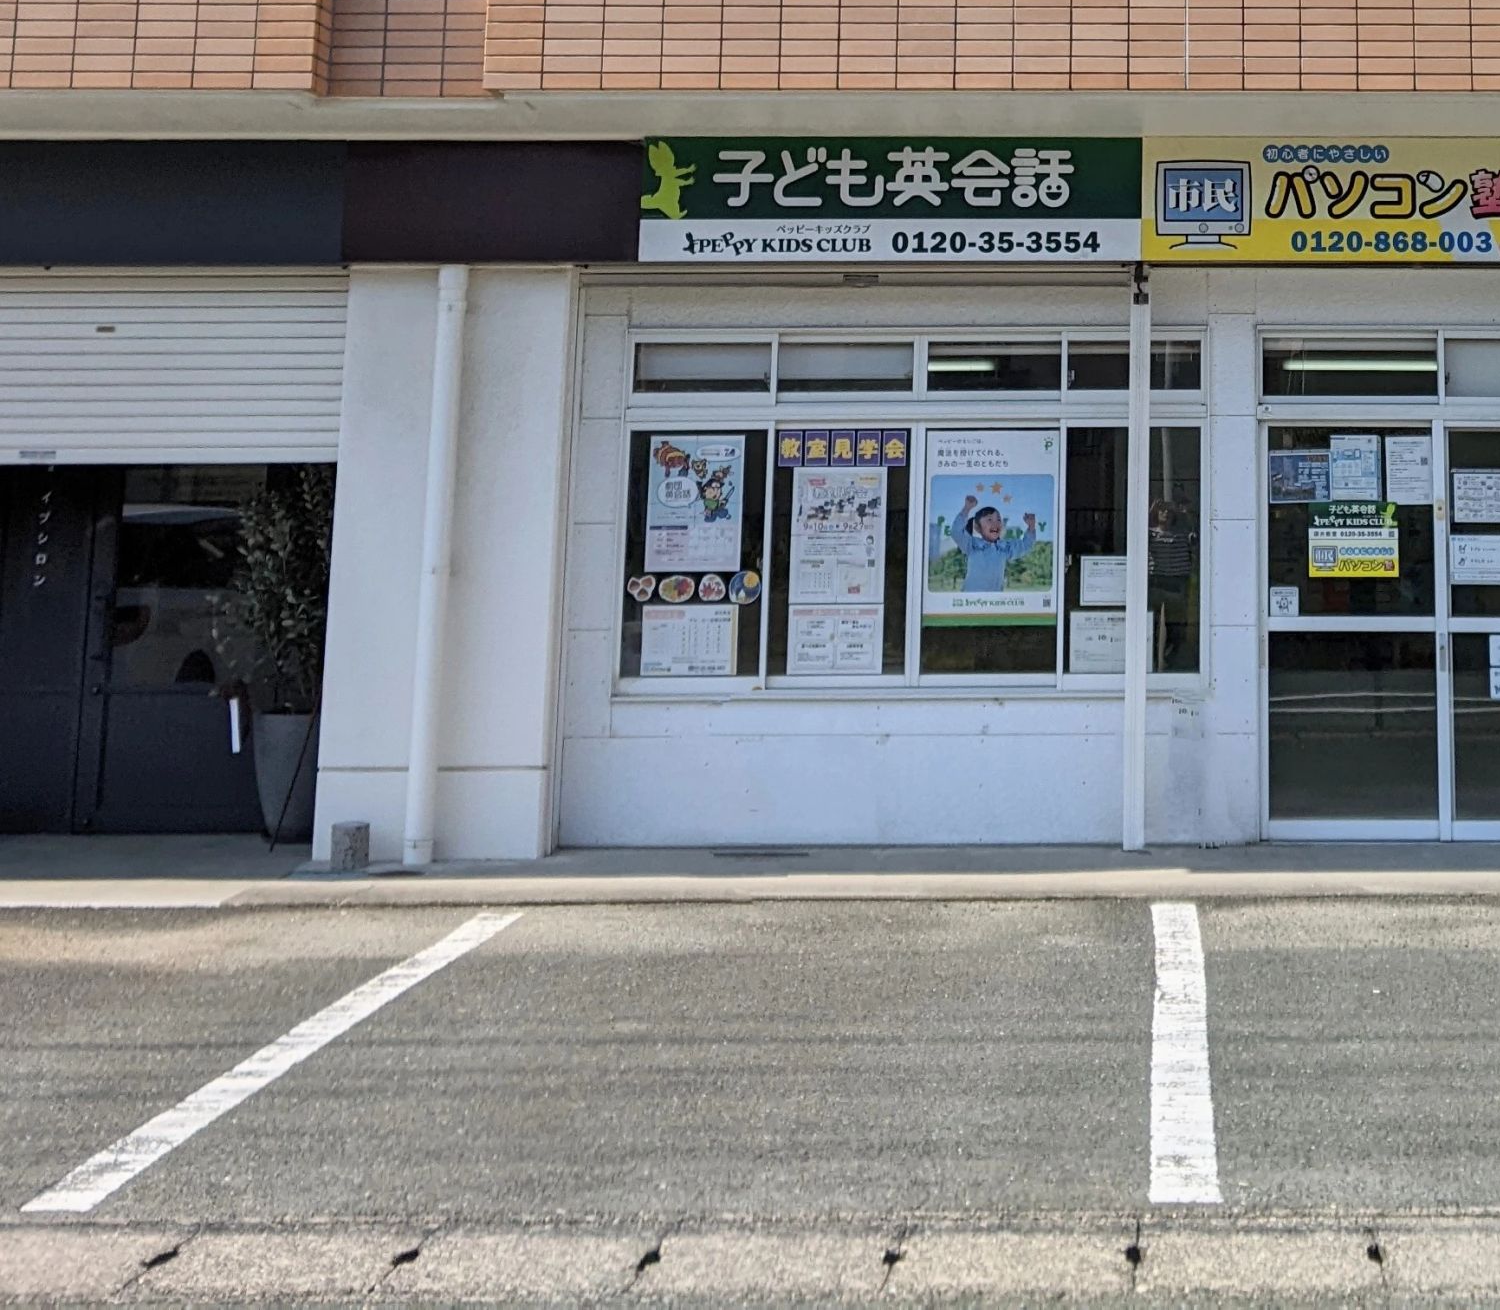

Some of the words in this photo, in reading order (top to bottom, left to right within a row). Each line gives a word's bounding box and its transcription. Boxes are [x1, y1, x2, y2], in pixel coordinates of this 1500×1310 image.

[1265, 147, 1388, 162] 初心者にやさしい
[713, 146, 1075, 207] 子ども英会話
[1168, 178, 1239, 213] 市民
[776, 224, 872, 235] ペッピーキッズクラブ
[696, 233, 758, 256] PEPPY
[762, 238, 812, 253] KIDS
[816, 238, 872, 253] CLUB
[891, 231, 1101, 254] 0120-35-3554
[1291, 231, 1493, 254] 0120-868-003
[780, 437, 905, 460] 教室見学会
[1346, 518, 1368, 526] KIDS
